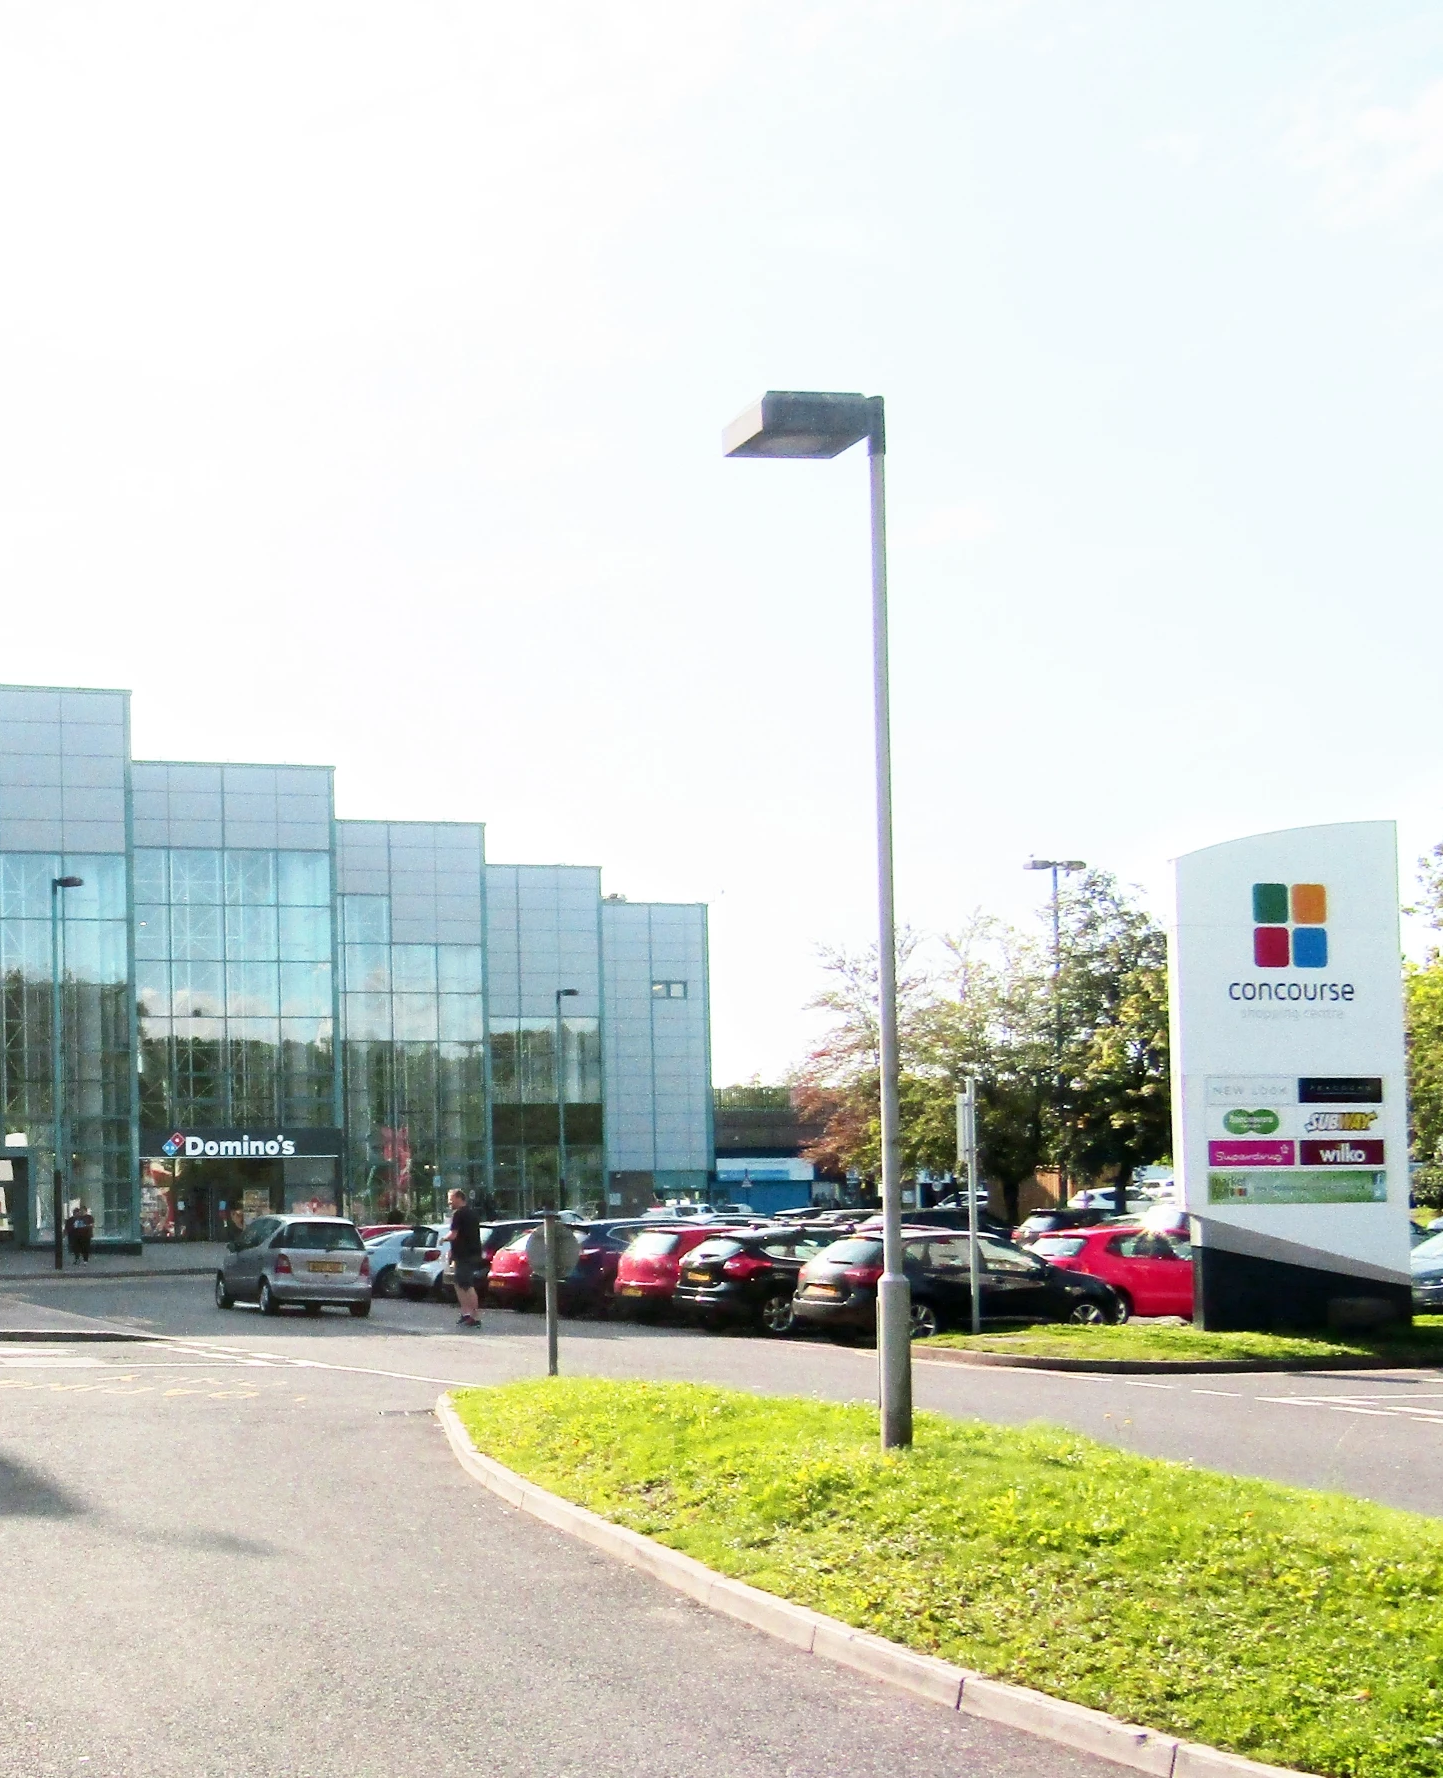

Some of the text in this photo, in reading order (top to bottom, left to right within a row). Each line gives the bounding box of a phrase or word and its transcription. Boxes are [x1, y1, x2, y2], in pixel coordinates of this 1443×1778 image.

[1228, 982, 1355, 1001] concourse
[1304, 1110, 1378, 1133] SUBWAY
[185, 1134, 296, 1156] Domino's
[1319, 1142, 1366, 1162] wilko
[1215, 1151, 1283, 1163] Superdrug
